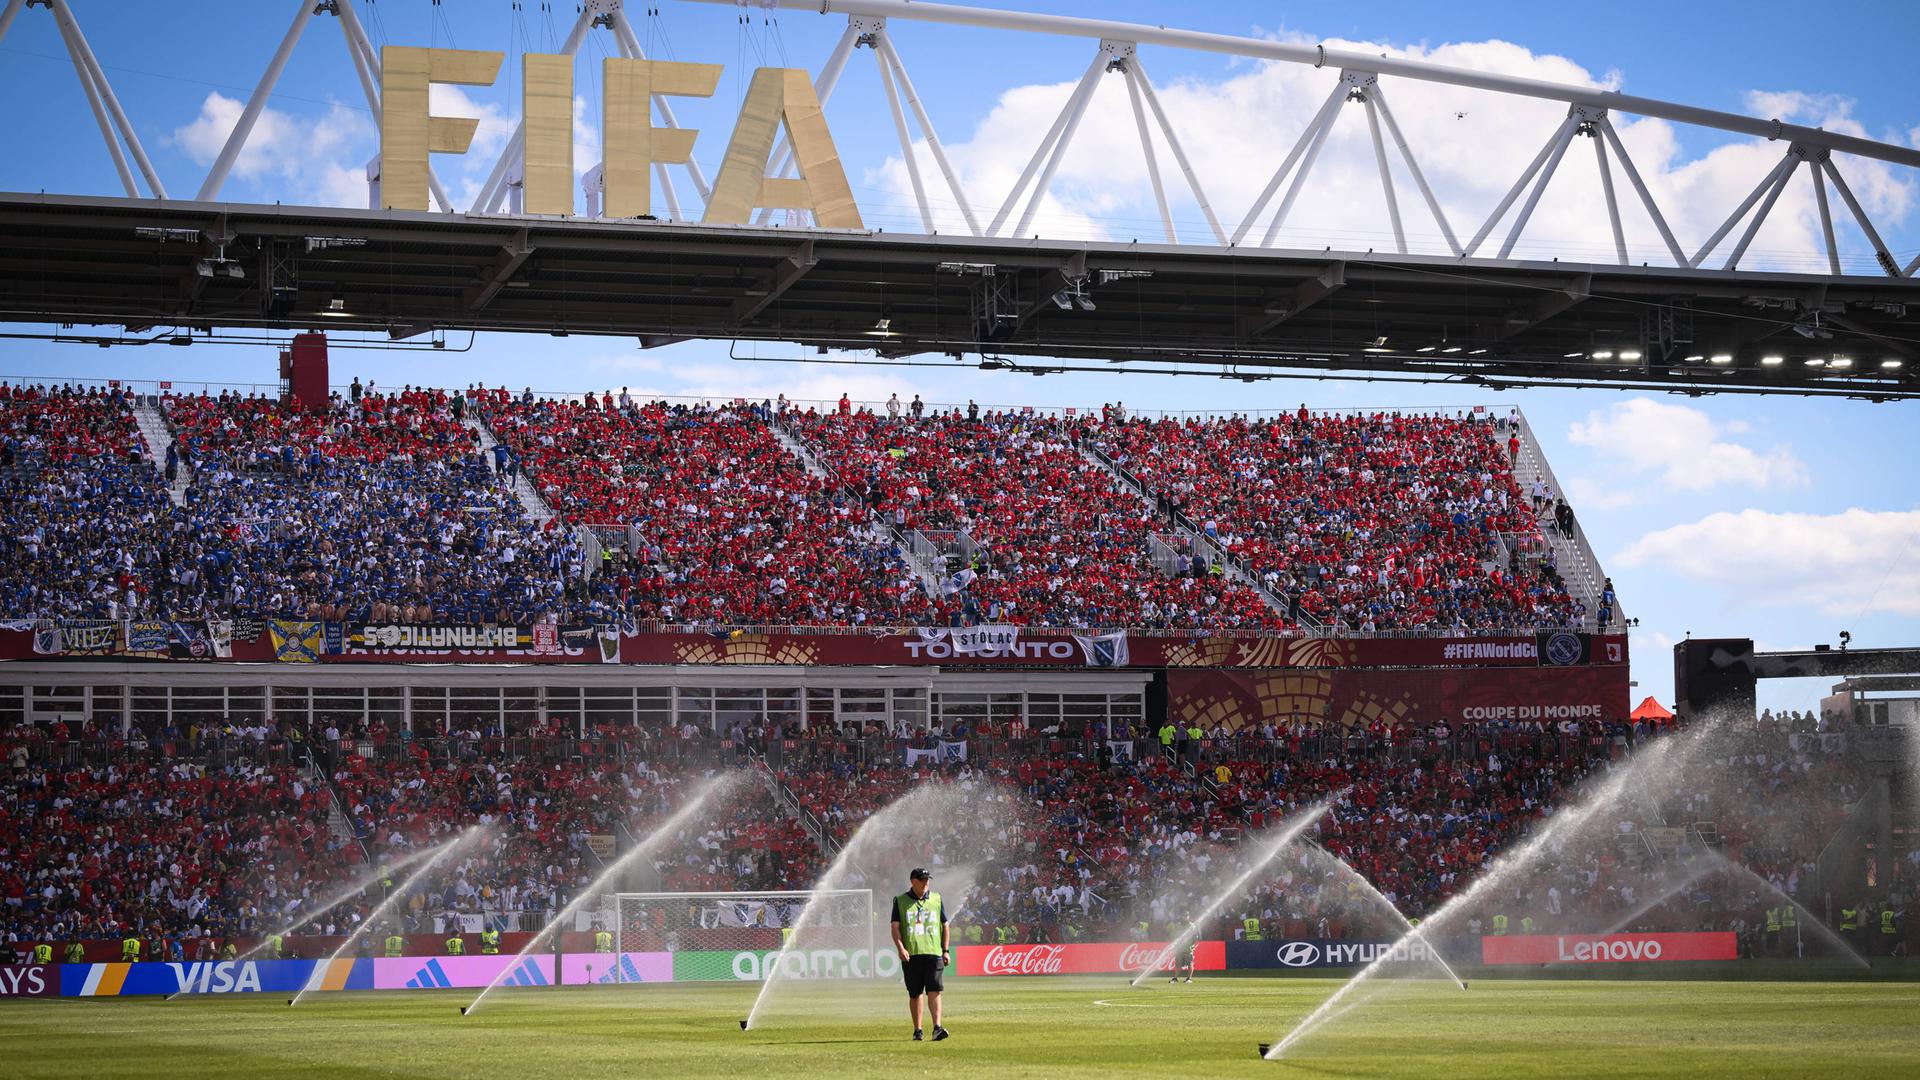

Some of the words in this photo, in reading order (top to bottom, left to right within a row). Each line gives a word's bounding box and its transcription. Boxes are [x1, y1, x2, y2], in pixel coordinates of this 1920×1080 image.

[381, 46, 864, 229] FIFA
[62, 626, 112, 648] VITEZ
[961, 632, 1012, 645] STOLAC
[1463, 707, 1515, 720] COUPE
[1519, 707, 1541, 718] DU
[1545, 705, 1601, 718] MONDE
[341, 740, 353, 749] 115
[721, 740, 733, 748] 115
[907, 925, 939, 936] PCH
[984, 944, 1065, 974] Coca-Cola
[1559, 937, 1662, 961] Lenovo
[732, 949, 900, 980] aramco
[165, 961, 262, 993] VISA
